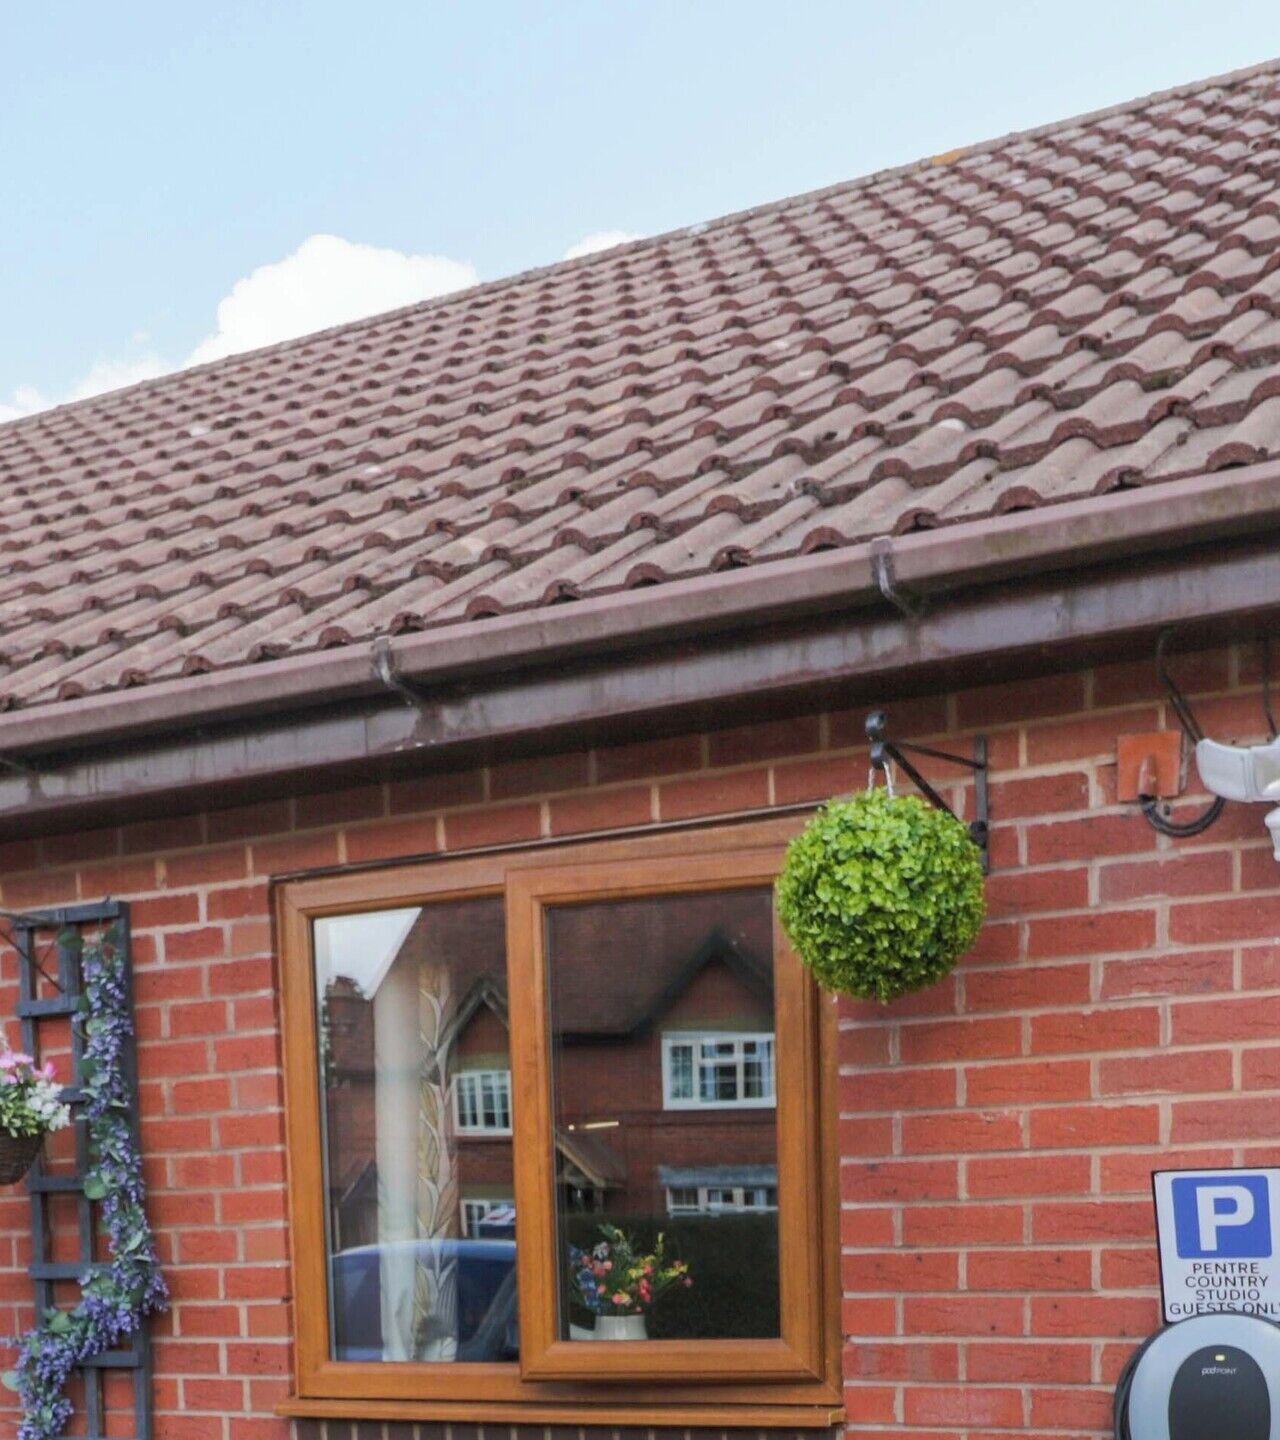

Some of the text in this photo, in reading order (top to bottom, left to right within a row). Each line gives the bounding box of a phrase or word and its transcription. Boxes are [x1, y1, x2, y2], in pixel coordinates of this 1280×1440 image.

[1196, 1186, 1254, 1251] P
[1192, 1263, 1260, 1275] PENTRE
[1184, 1276, 1269, 1288] COUNTRY
[1195, 1289, 1261, 1301] STUDIO
[1169, 1302, 1237, 1315] GUESTS
